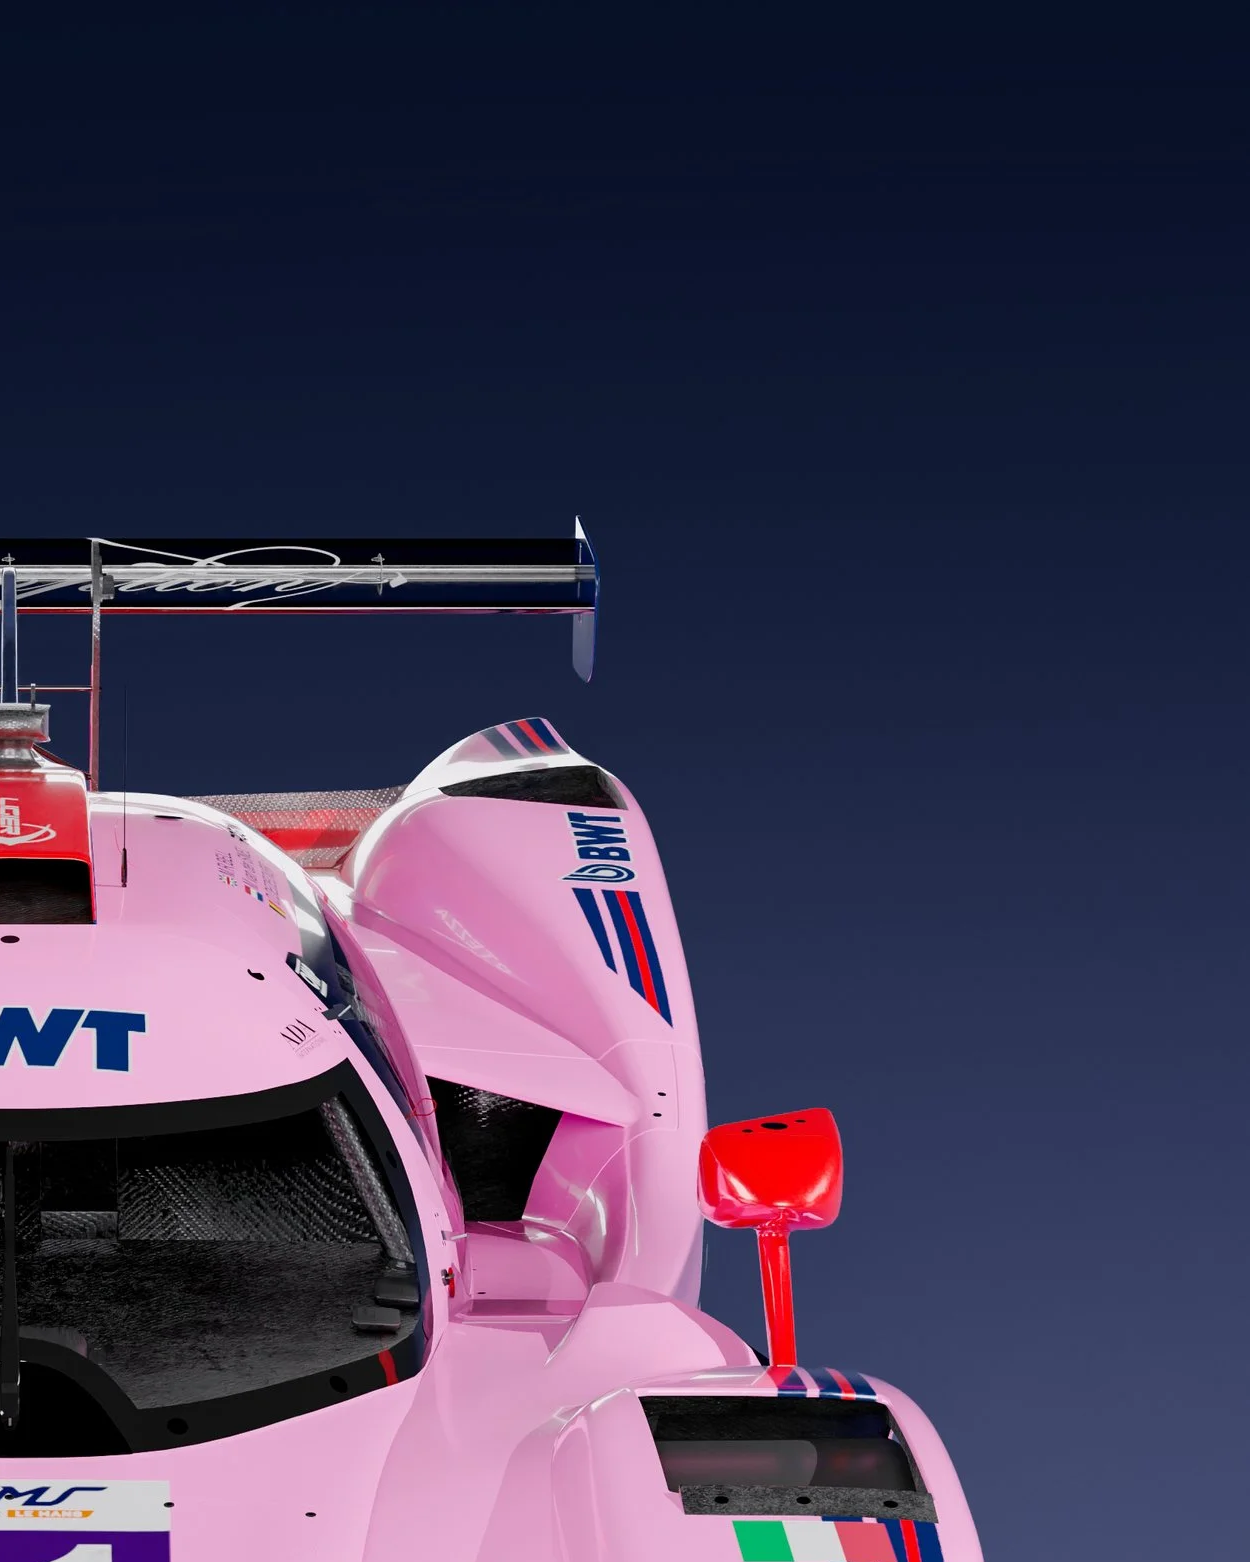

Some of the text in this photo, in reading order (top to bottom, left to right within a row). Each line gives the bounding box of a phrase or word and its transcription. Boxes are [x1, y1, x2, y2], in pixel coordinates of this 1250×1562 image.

[567, 811, 631, 862] BWT
[279, 1017, 317, 1050] ADA
[14, 1509, 32, 1518] LE
[38, 1509, 82, 1518] MANS
